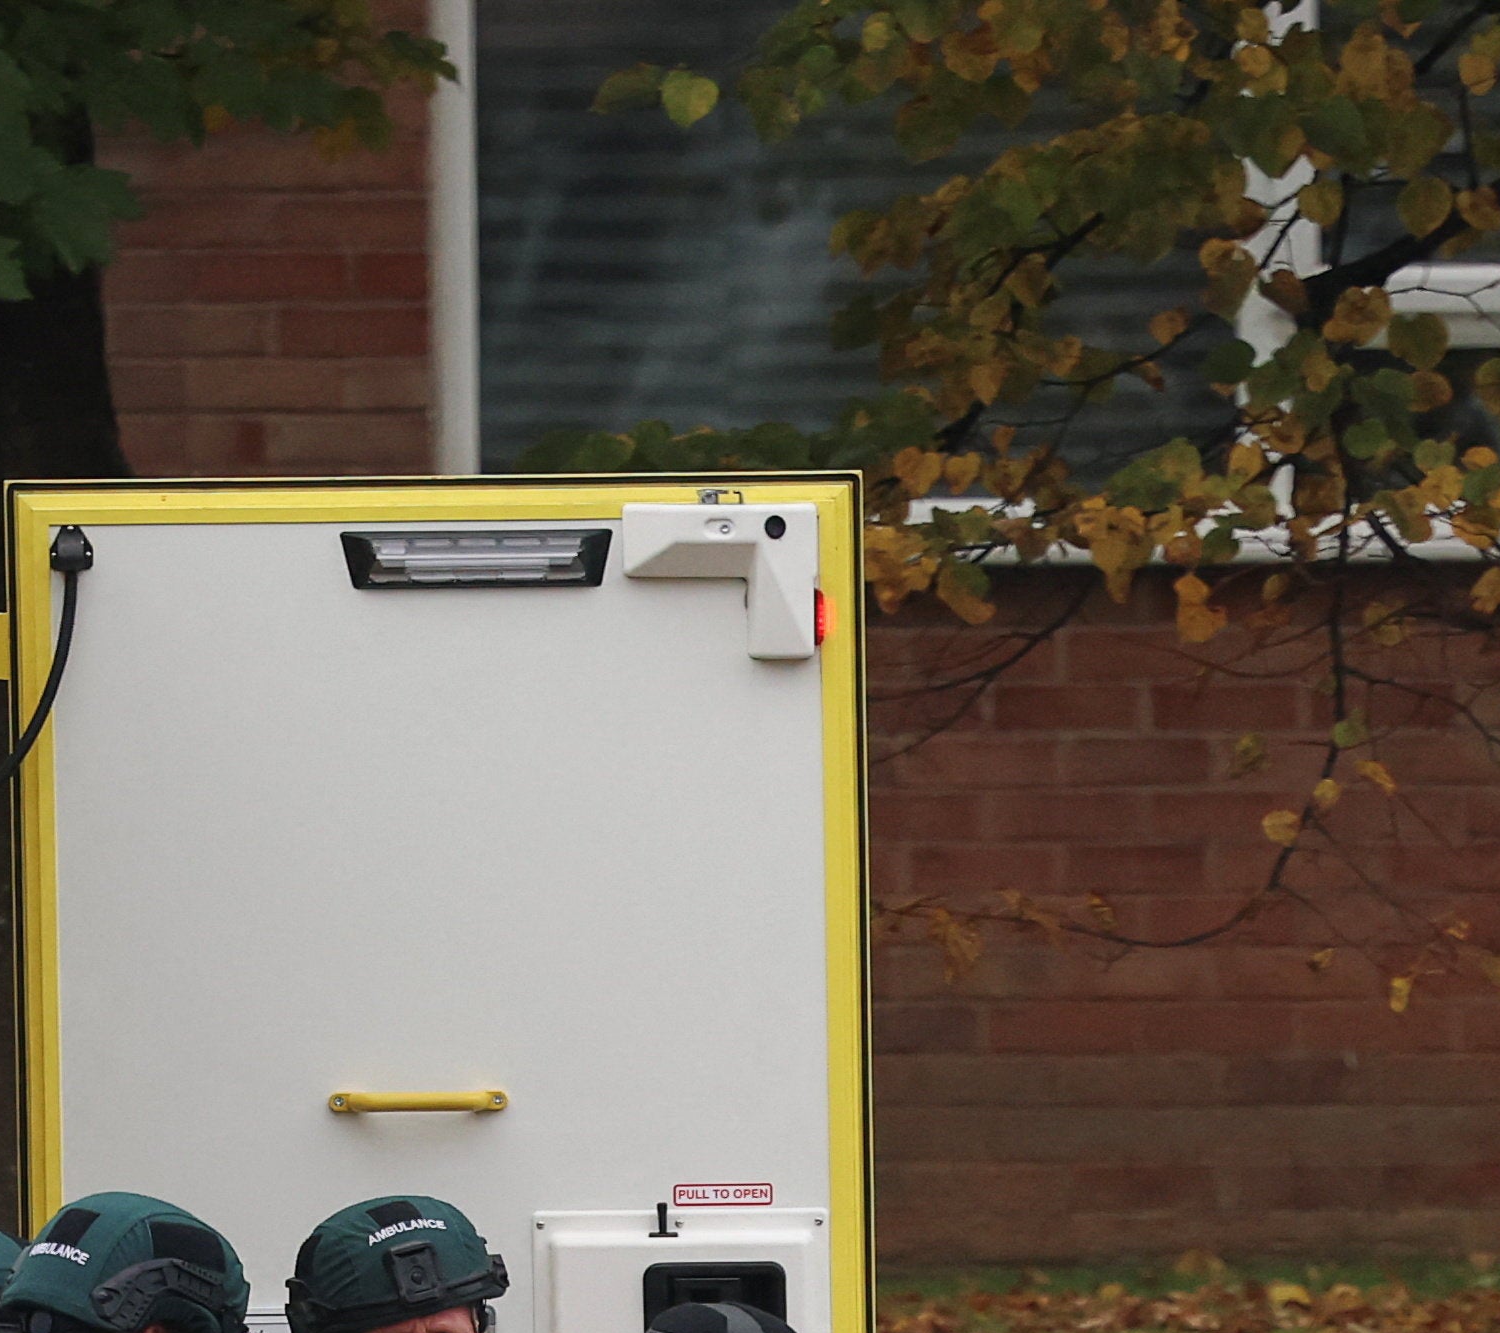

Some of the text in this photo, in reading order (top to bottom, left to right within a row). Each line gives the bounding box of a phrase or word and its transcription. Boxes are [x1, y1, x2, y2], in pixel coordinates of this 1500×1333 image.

[678, 1188, 768, 1200] PULL TO OPEN
[368, 1218, 447, 1247] AMBULANCE
